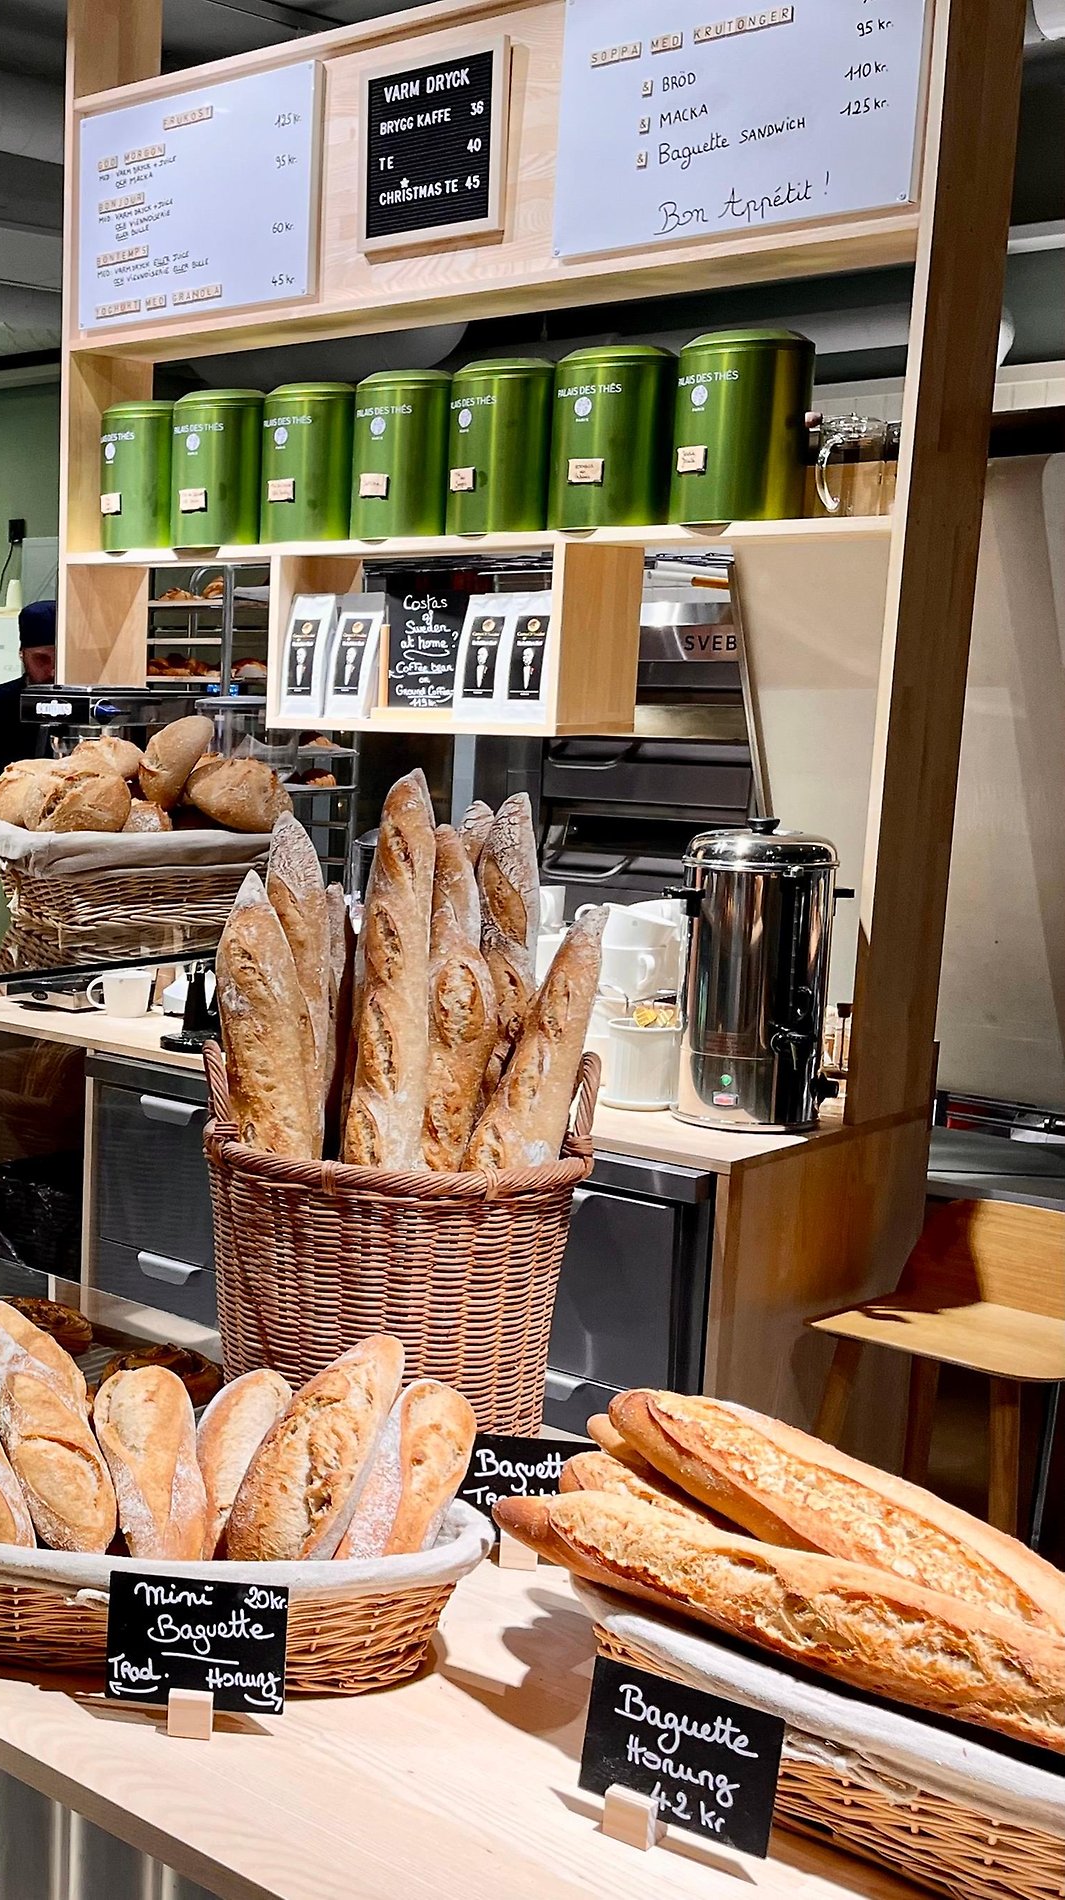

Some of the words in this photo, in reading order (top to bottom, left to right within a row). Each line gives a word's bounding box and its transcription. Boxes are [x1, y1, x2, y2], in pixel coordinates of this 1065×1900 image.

[591, 44, 640, 65] SOPPA
[651, 35, 681, 51] MED
[693, 7, 790, 40] KRUTONGER
[662, 70, 696, 93] BRÖD
[856, 20, 874, 37] 95
[383, 80, 420, 103] VARM
[426, 68, 471, 94] DRYCK
[659, 103, 709, 129] MACKA
[844, 62, 872, 81] 110
[164, 106, 212, 129] FRUKOST
[379, 116, 414, 136] BRYGG
[417, 108, 452, 128] KAFFE
[470, 101, 484, 116] 36
[658, 132, 730, 171] Baguette
[839, 97, 871, 116] 125
[98, 157, 116, 171] GOD
[123, 145, 163, 162] MORGON
[379, 156, 394, 171] TE
[467, 138, 482, 153] 40
[98, 193, 142, 212] BONJOUR
[379, 182, 442, 206] CHRISTMAS
[445, 179, 459, 193] TE
[465, 175, 481, 190] 45
[653, 201, 709, 236] Bon
[718, 179, 814, 223] Appétit
[96, 246, 147, 266] BONTEMPS
[272, 222, 284, 234] 60
[145, 296, 164, 307] MED
[172, 287, 220, 302] GRANOLA
[271, 274, 284, 286] 45
[557, 386, 578, 398] PALAIS
[579, 385, 596, 395] DES
[696, 372, 712, 383] DES
[374, 406, 389, 416] DES
[402, 593, 448, 611] Costas
[400, 634, 415, 649] at
[404, 619, 451, 635] Sweden
[474, 1448, 564, 1493] Baguett
[147, 1608, 275, 1655] Baguette
[614, 1683, 759, 1759] Baguette
[626, 1733, 741, 1808] Honung
[650, 1781, 691, 1821] 42
[699, 1800, 726, 1833] kr
